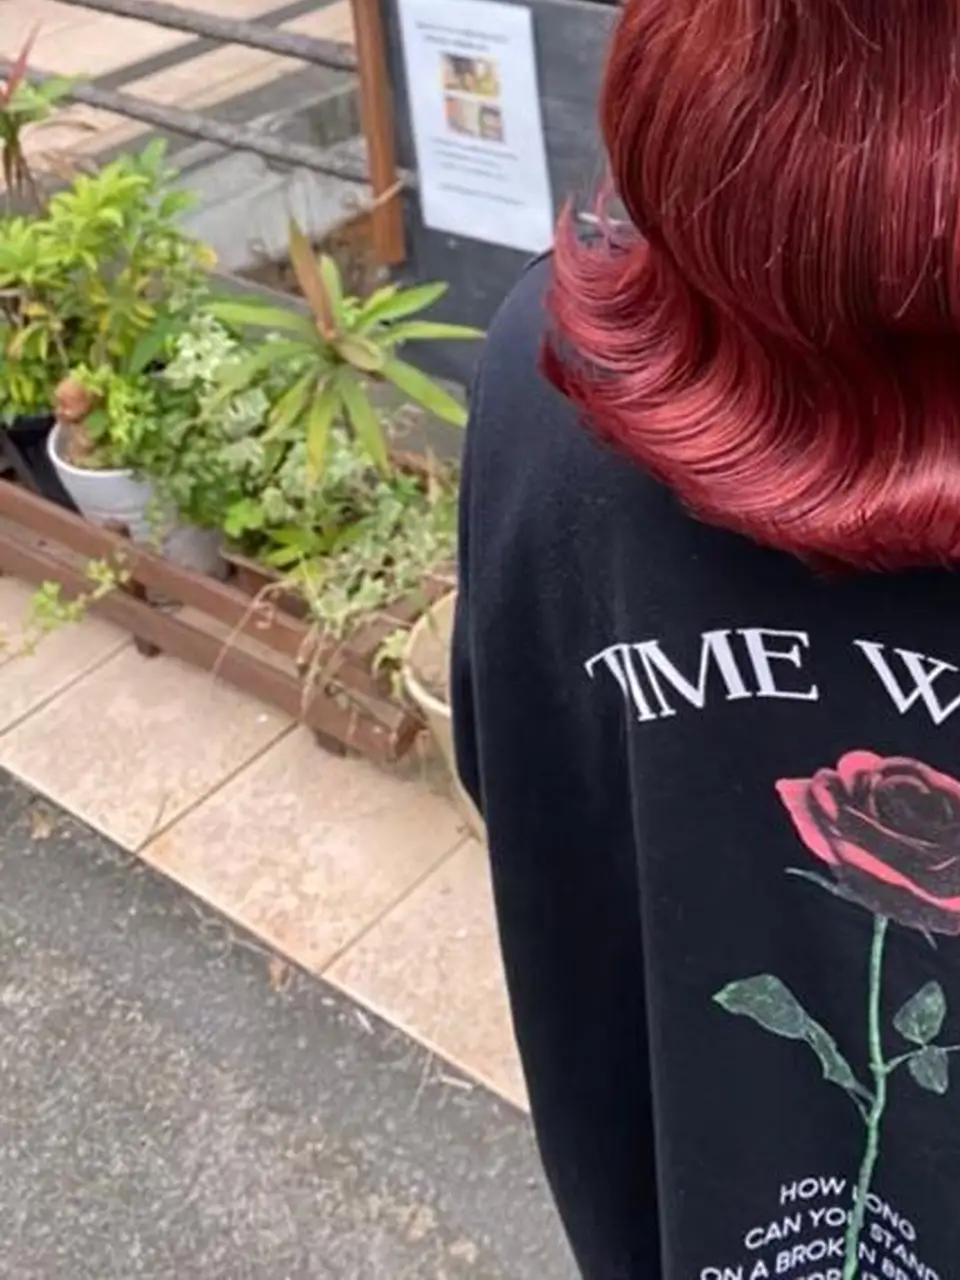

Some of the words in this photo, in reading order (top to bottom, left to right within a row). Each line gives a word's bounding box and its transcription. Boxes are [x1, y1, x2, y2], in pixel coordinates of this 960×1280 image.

[584, 627, 819, 722] TIME
[779, 1176, 846, 1205] HOW
[744, 1213, 802, 1249] CAN
[775, 1237, 877, 1274] BROKN
